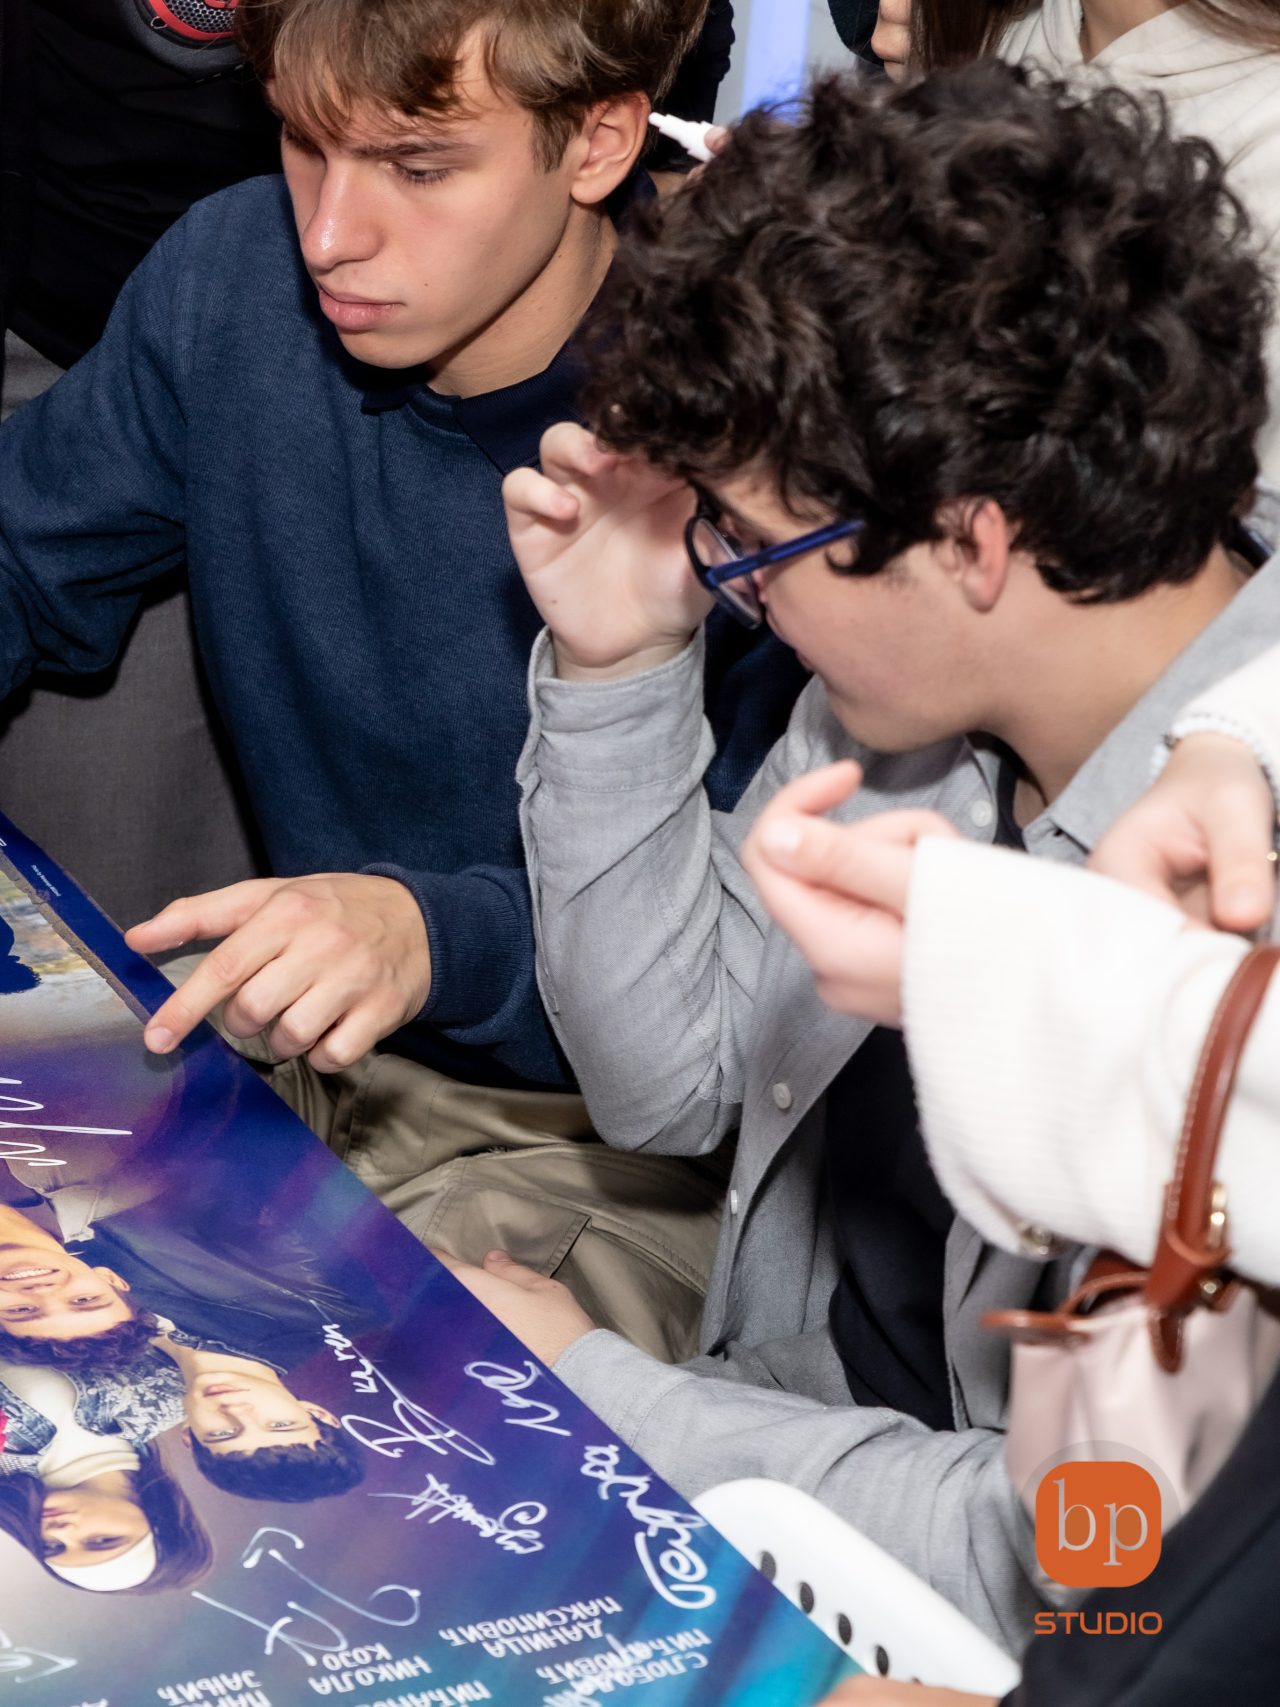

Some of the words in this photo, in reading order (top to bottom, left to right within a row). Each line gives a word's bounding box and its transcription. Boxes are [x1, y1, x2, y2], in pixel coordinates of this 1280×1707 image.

[438, 1595, 623, 1647] МАКСИМОВИЋ
[482, 1618, 603, 1658] ДАНИЦА
[307, 1654, 432, 1695] НИКОЛА
[321, 1641, 392, 1671] КОЈО
[156, 1669, 262, 1700] ЈАЊИЋ
